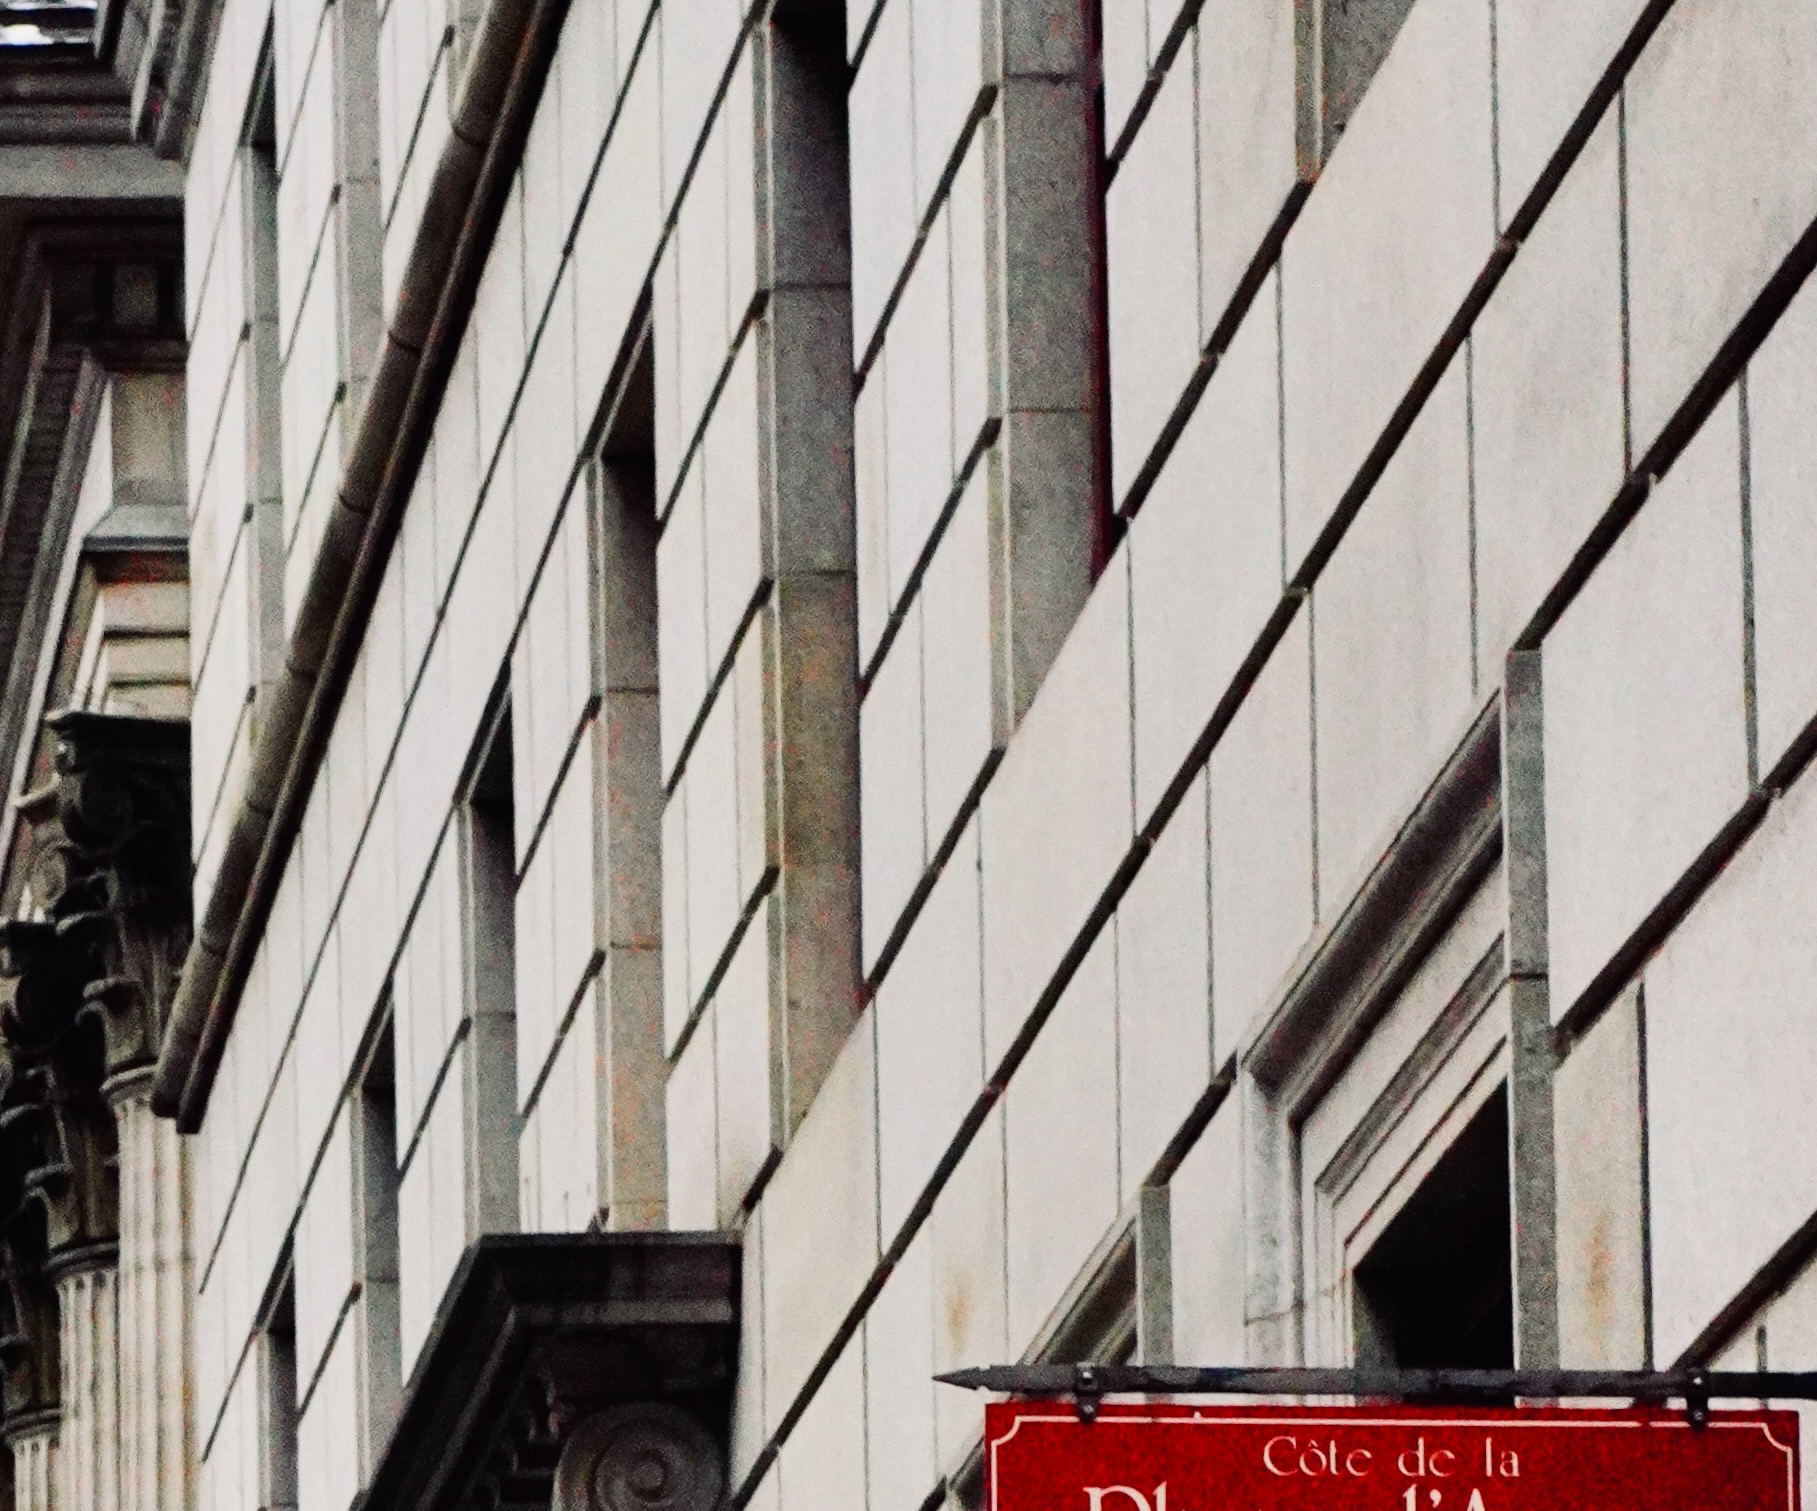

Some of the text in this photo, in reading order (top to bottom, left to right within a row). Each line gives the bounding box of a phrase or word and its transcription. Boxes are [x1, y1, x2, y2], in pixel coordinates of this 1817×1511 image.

[1262, 1435, 1521, 1478] Côte de la
